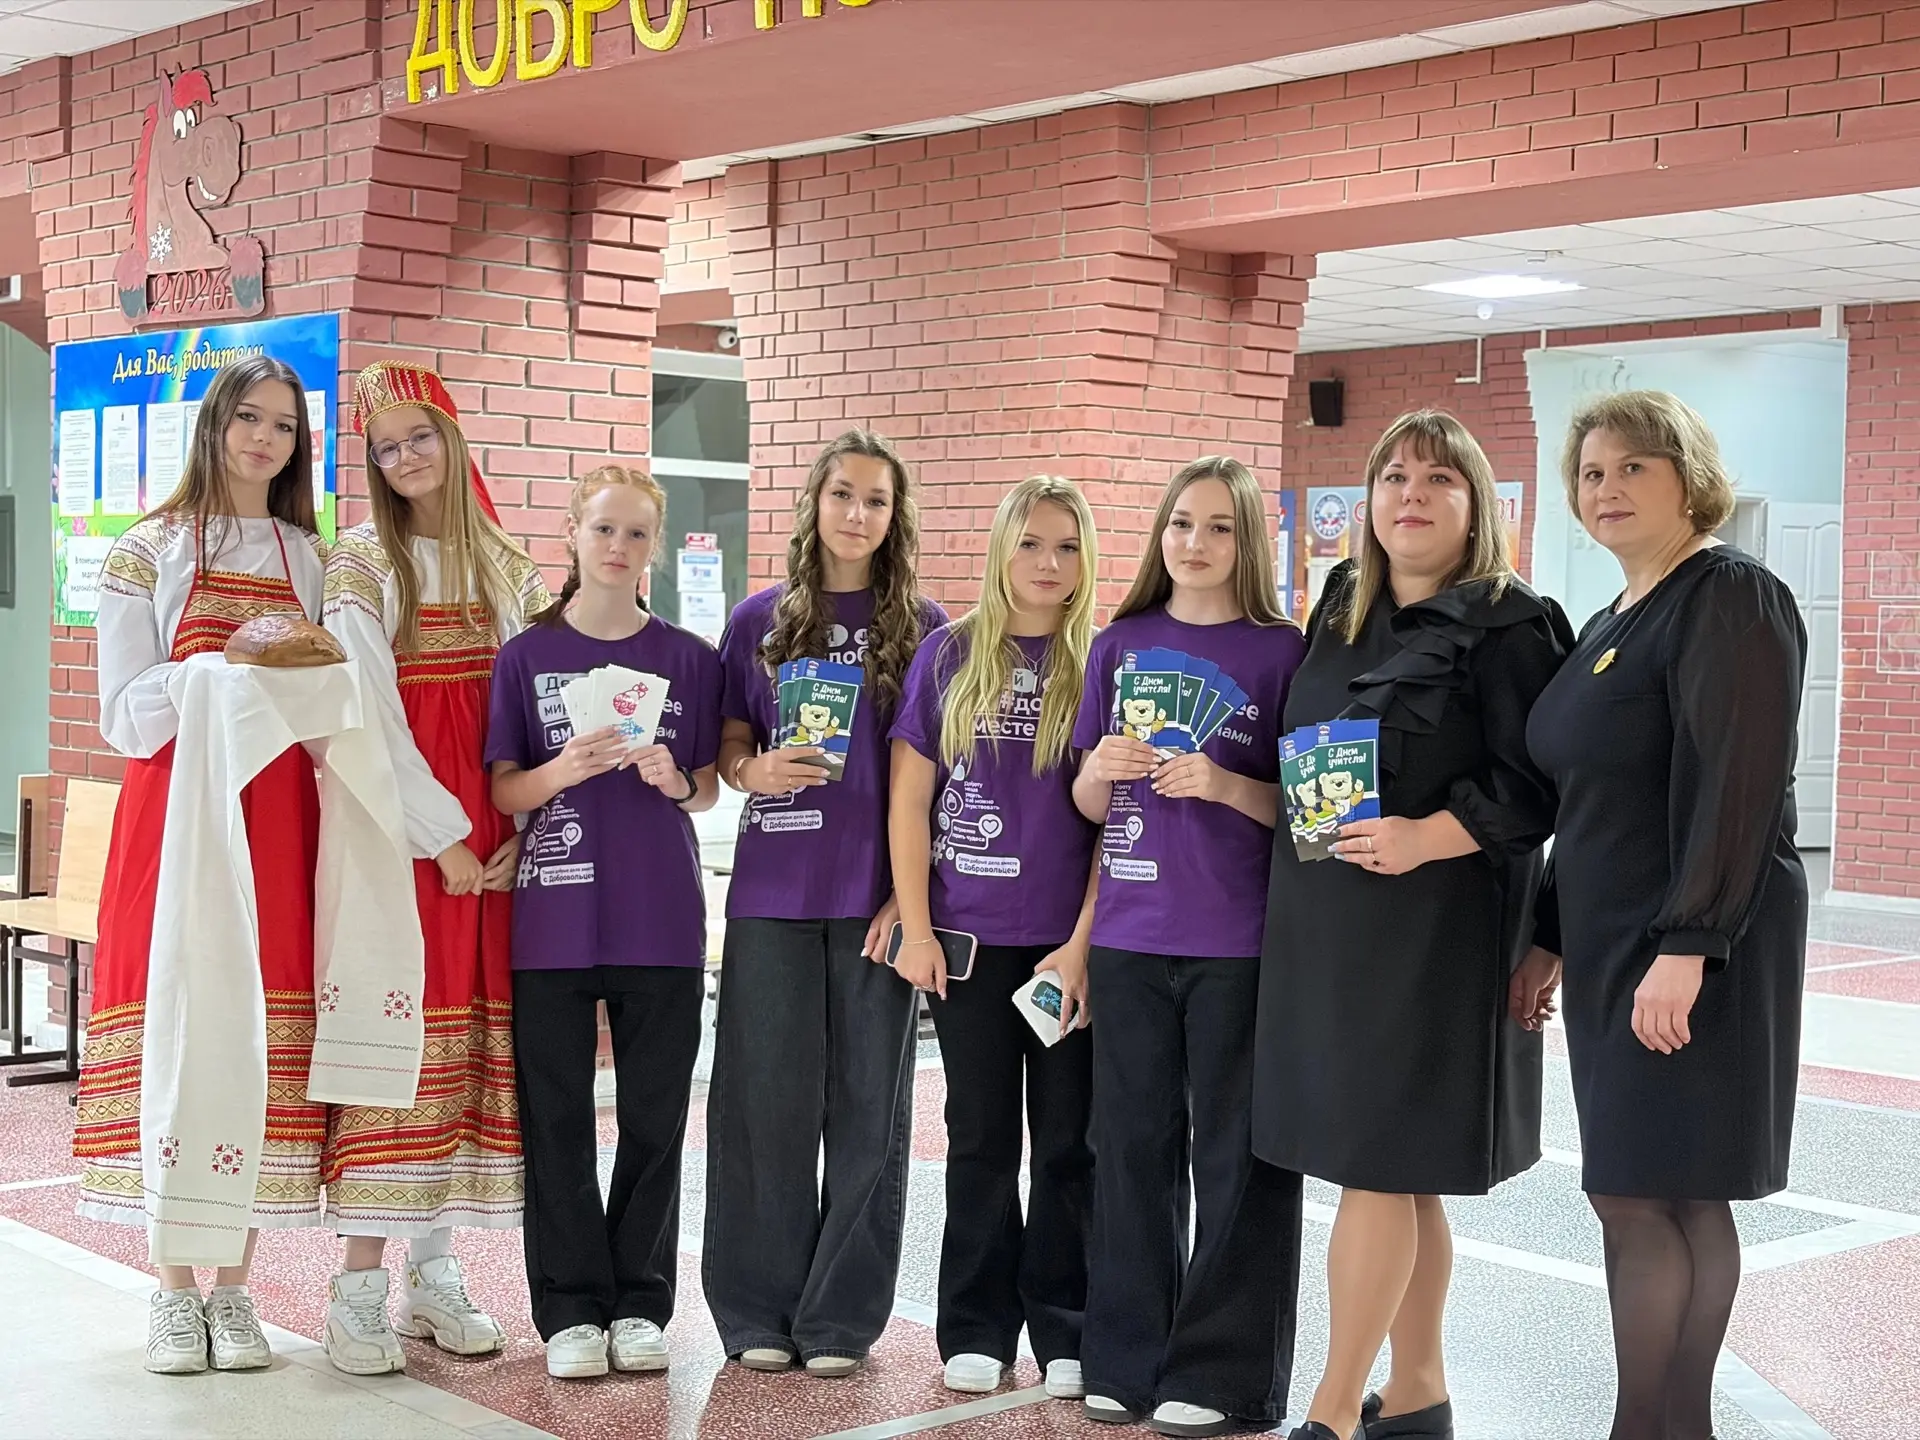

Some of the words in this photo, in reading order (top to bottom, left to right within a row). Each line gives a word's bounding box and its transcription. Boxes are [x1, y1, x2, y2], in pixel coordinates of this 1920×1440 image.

[150, 266, 231, 314] 2026
[112, 352, 142, 384] Для
[145, 348, 178, 379] Вас,
[1133, 676, 1140, 685] С
[1141, 676, 1163, 686] Днем
[813, 682, 820, 692] С
[820, 684, 841, 695] Днем
[1133, 684, 1171, 696] учителя!
[811, 692, 848, 704] учителя!
[974, 718, 1036, 736] месте
[1328, 748, 1334, 757] С
[1337, 747, 1358, 758] Днем
[1328, 752, 1367, 769] учителя!
[549, 873, 594, 884] Добровольце
